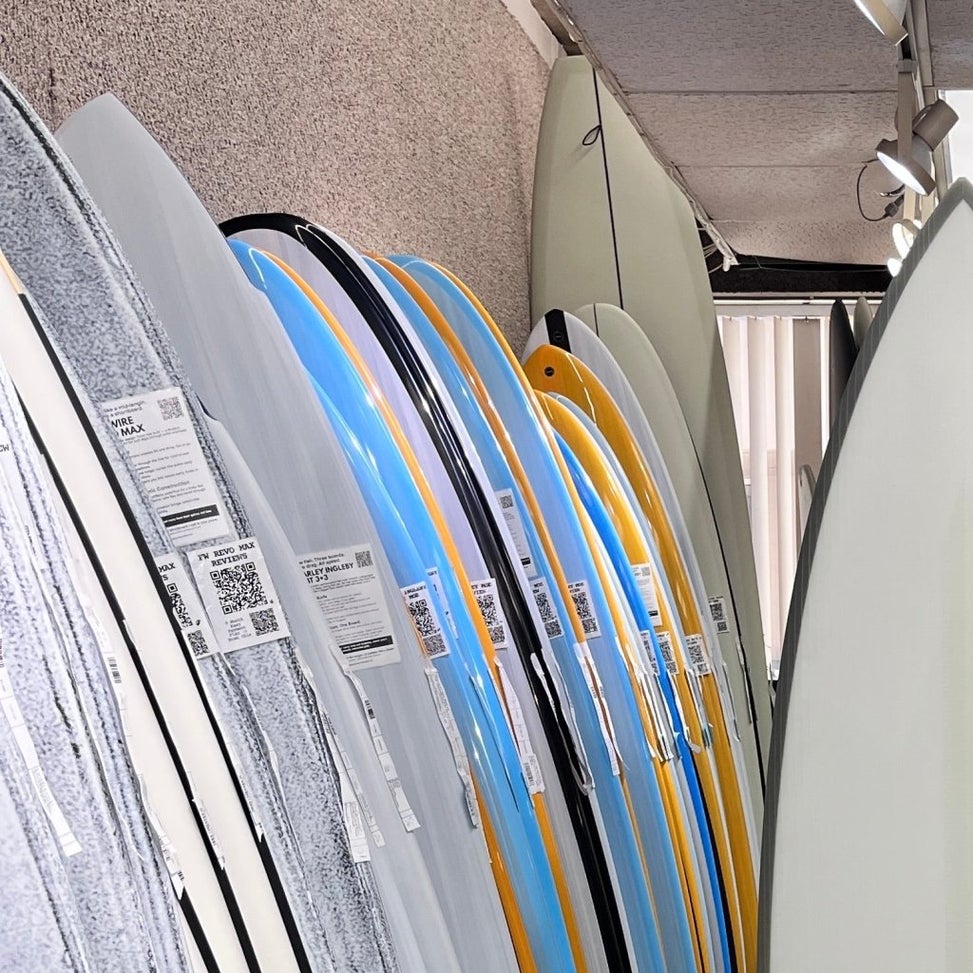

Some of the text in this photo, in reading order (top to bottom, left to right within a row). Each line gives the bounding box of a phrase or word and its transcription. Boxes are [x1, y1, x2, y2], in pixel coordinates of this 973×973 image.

[120, 424, 146, 437] MAX
[198, 541, 256, 561] FW REVO MAX
[211, 552, 248, 567] REVIEWS
[158, 562, 176, 573] MAX
[325, 562, 354, 574] INGLEBY
